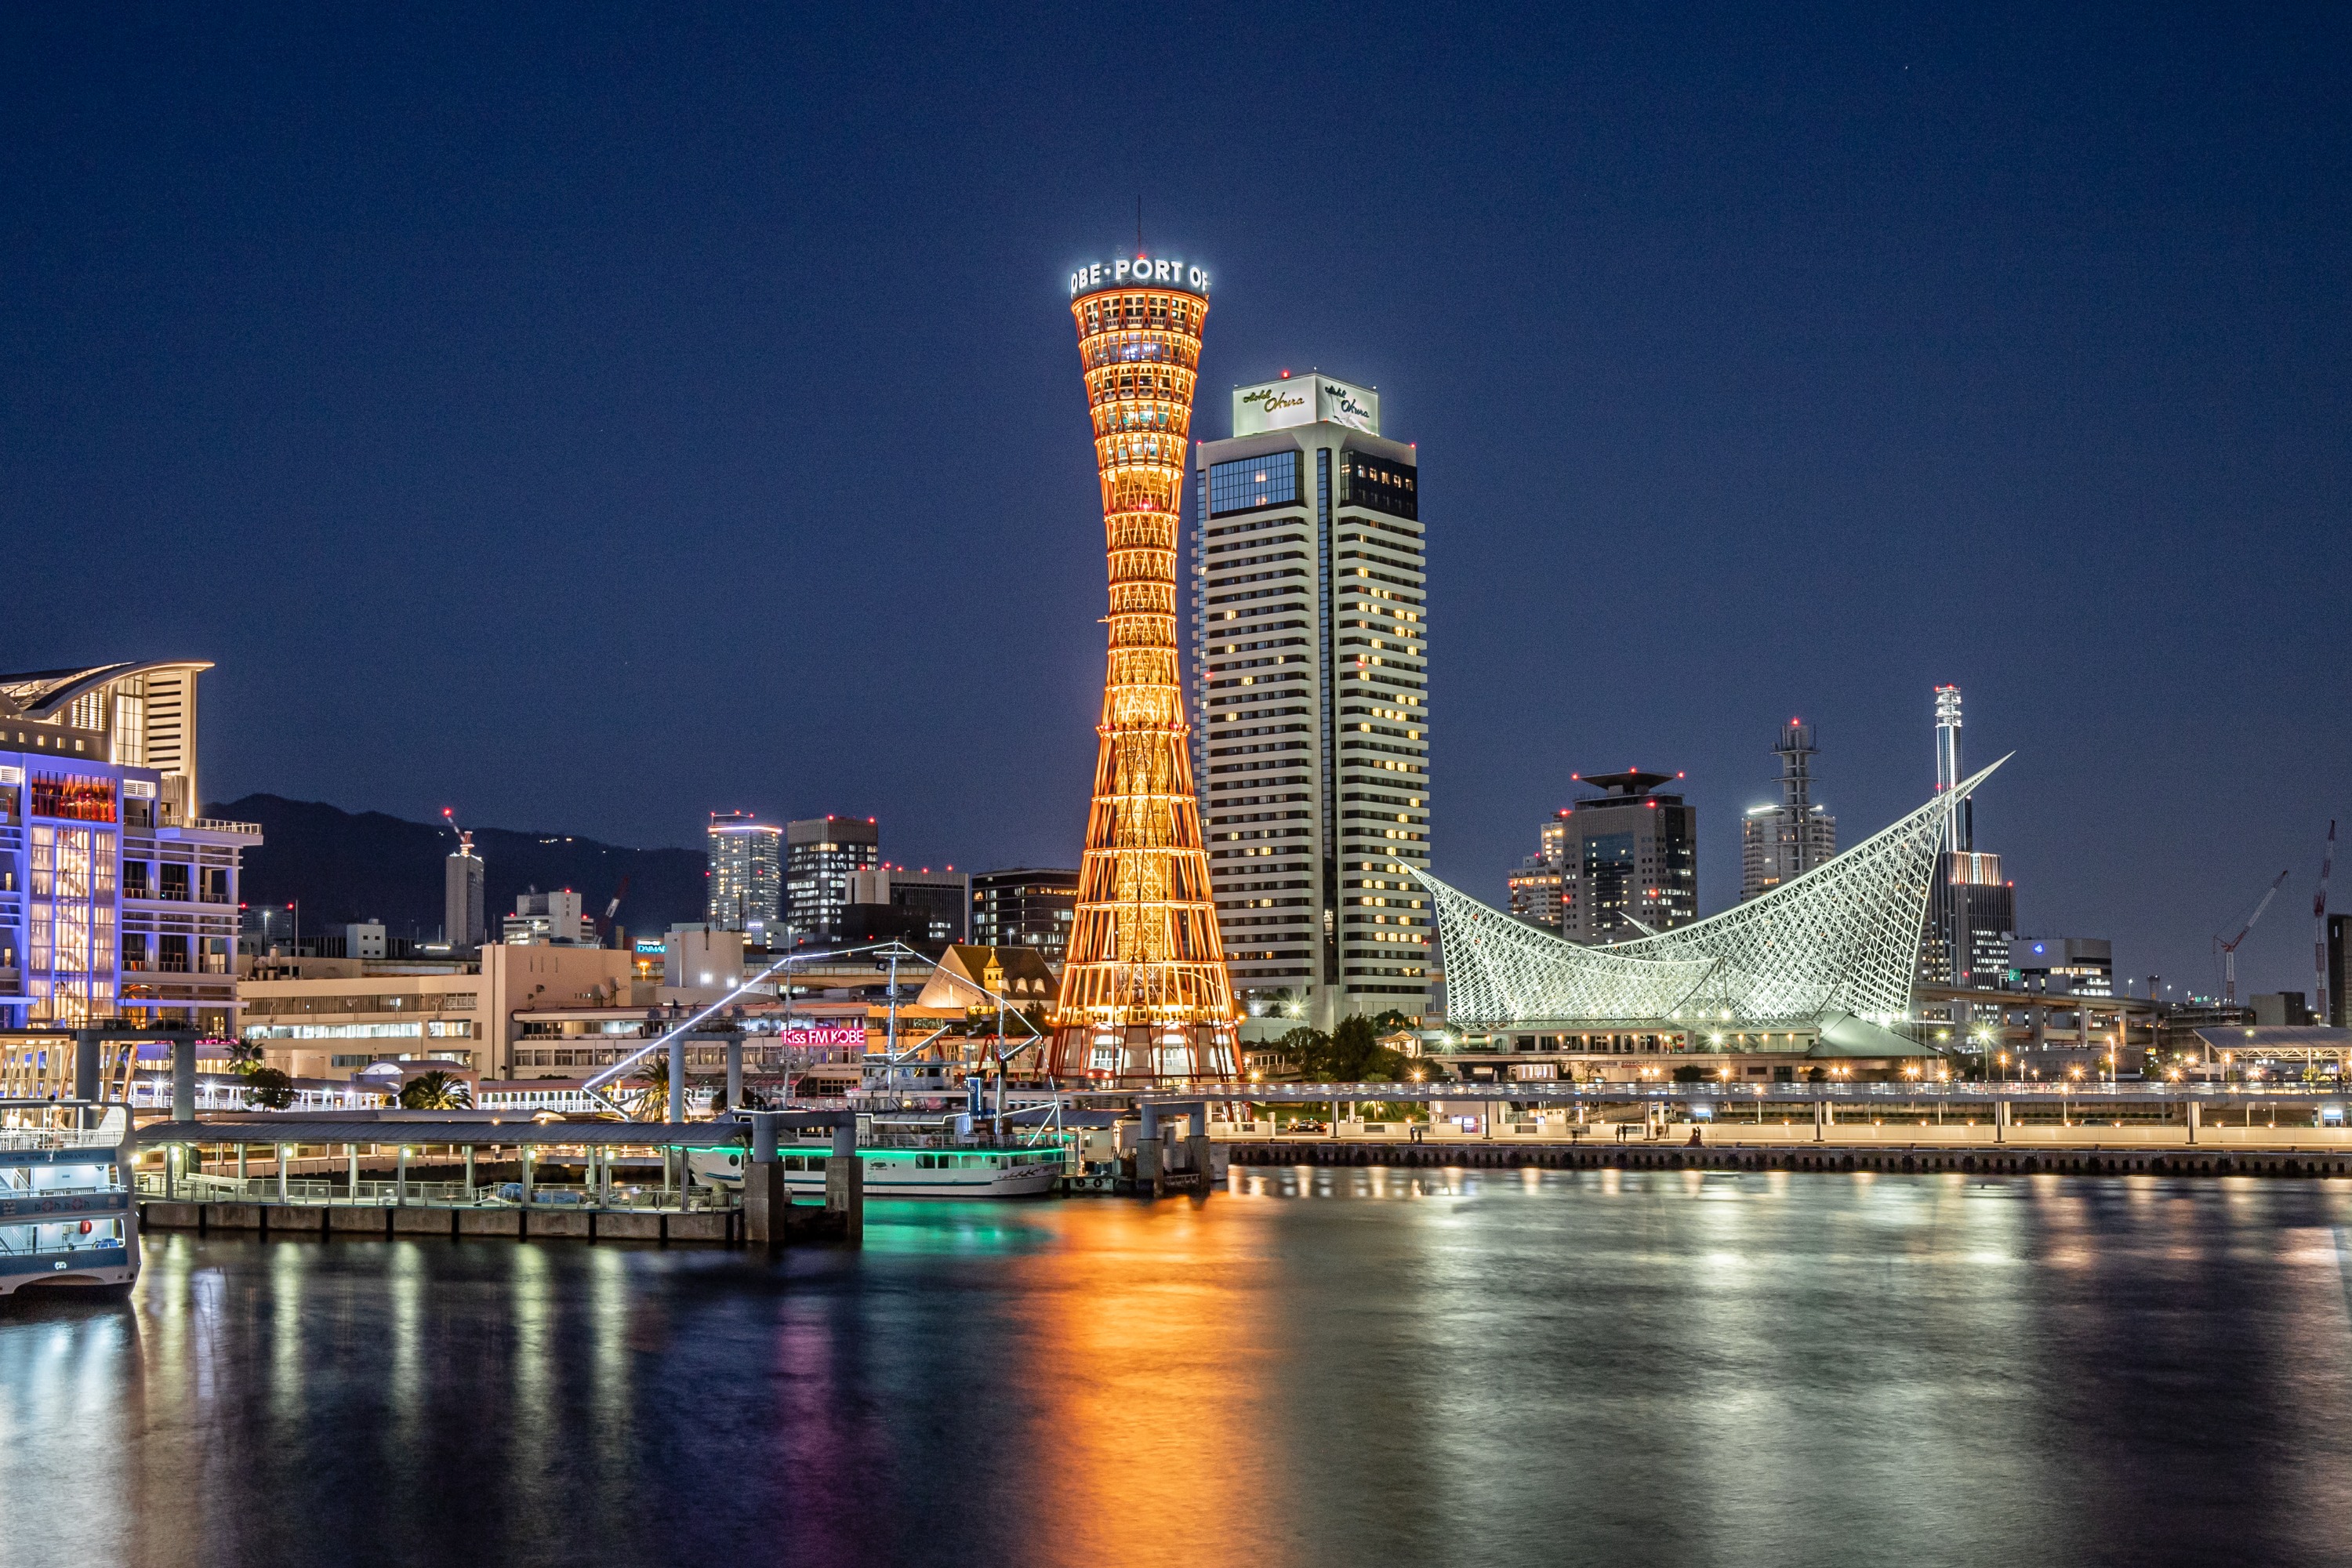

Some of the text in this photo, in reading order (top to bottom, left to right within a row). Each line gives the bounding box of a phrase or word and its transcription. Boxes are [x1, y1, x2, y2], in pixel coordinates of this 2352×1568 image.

[1116, 260, 1182, 281] PORT
[1189, 267, 1208, 292] OF
[1265, 392, 1305, 412] Okura
[1341, 398, 1370, 418] Okura
[784, 1029, 864, 1044] Kiss FM KOBE
